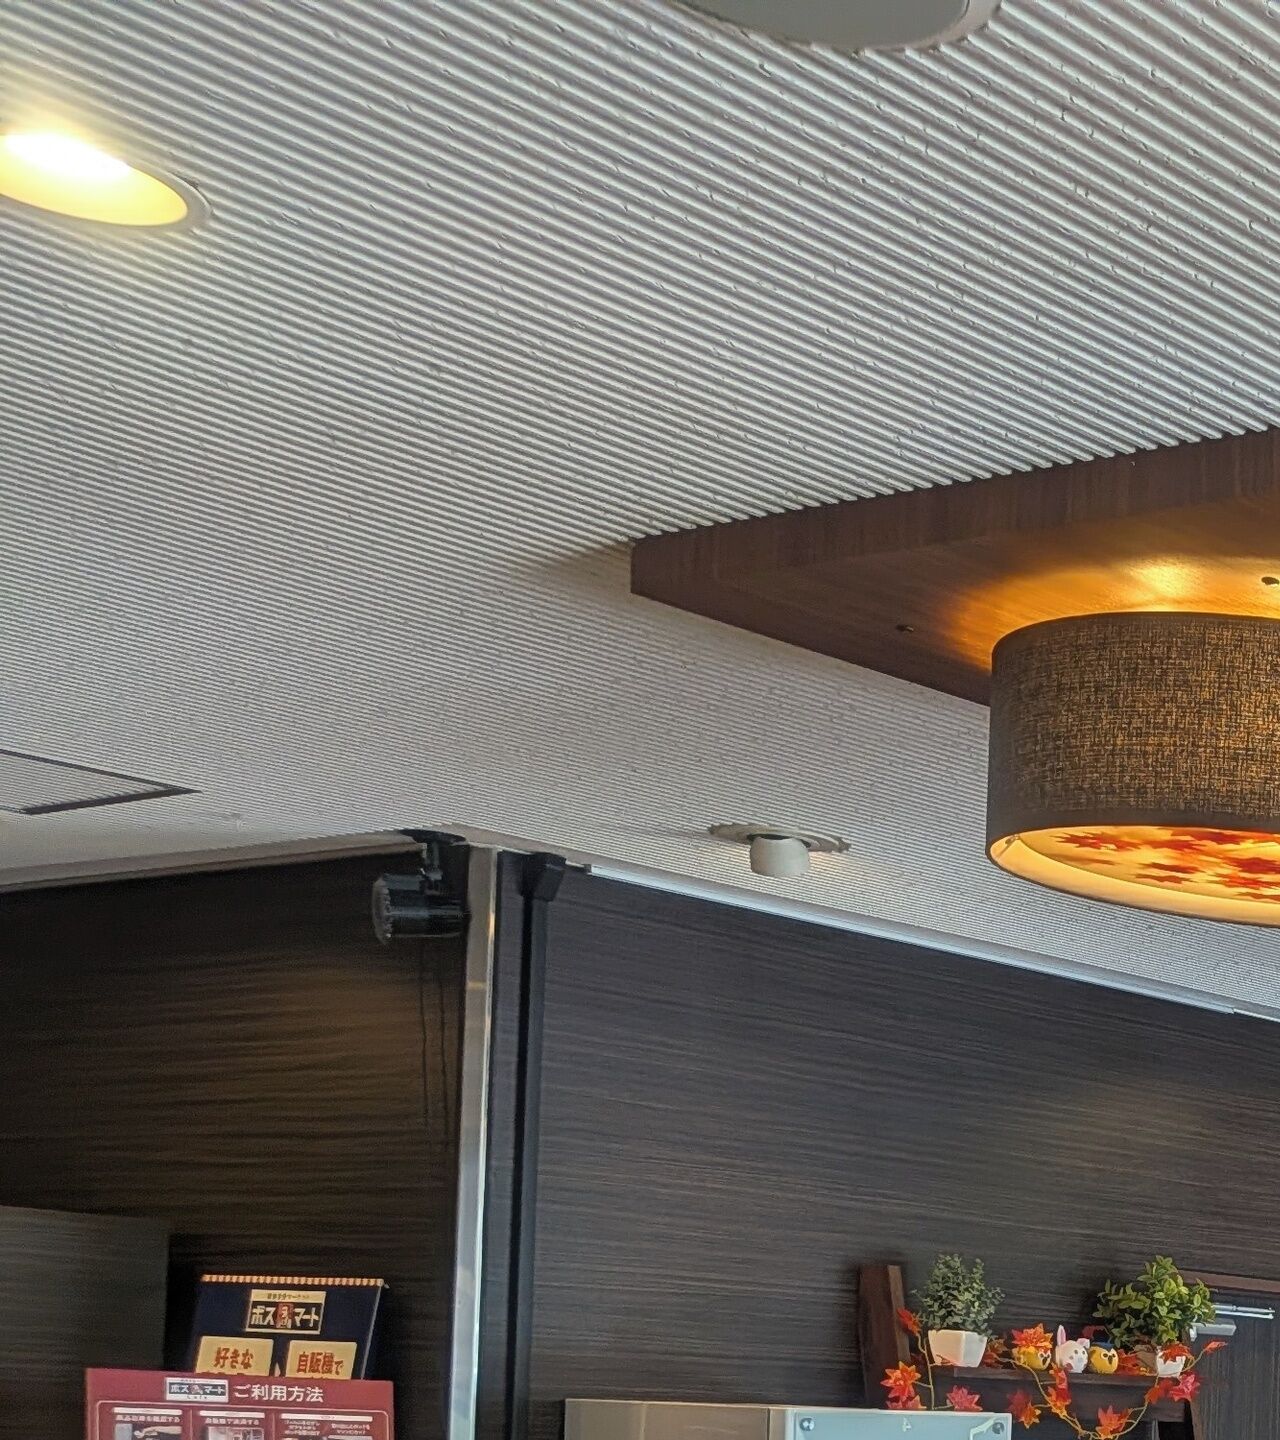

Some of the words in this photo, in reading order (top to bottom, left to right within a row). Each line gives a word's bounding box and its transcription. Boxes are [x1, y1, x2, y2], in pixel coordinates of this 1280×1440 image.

[213, 1347, 254, 1370] 好きな
[297, 1352, 344, 1375] 自販機で
[234, 1385, 324, 1403] ご利用方法
